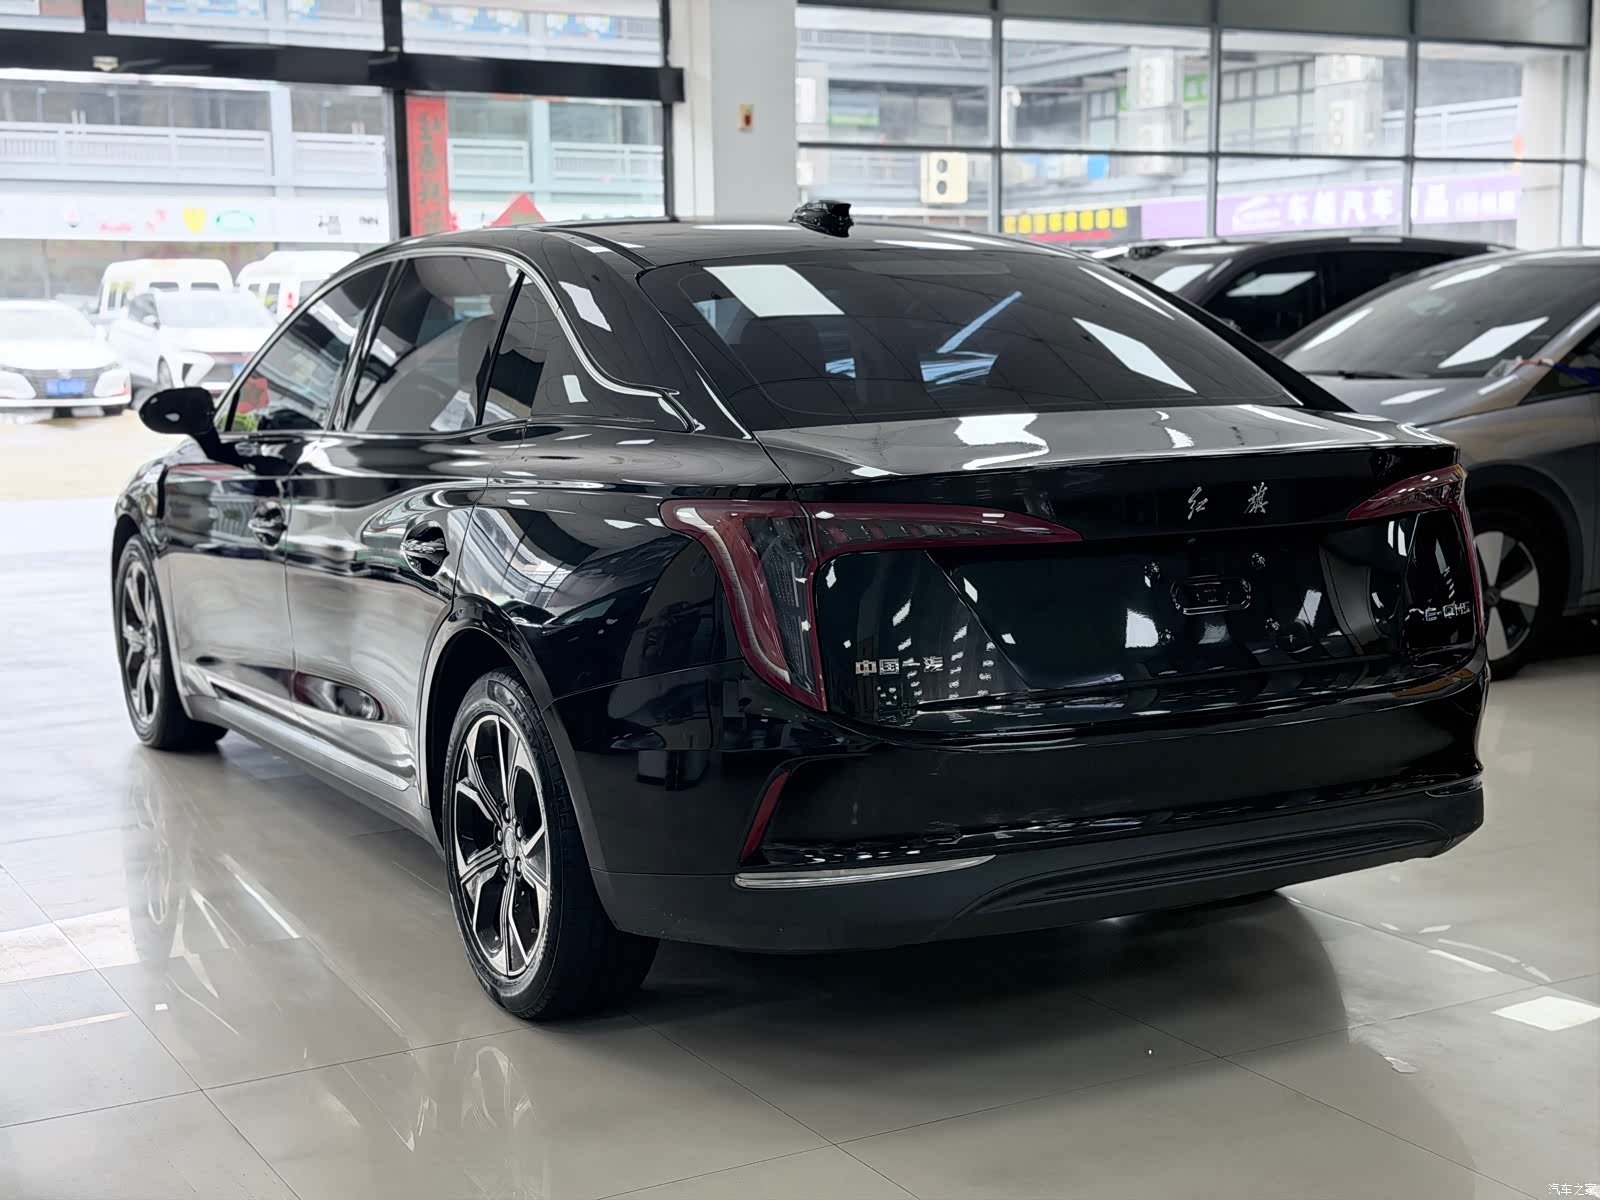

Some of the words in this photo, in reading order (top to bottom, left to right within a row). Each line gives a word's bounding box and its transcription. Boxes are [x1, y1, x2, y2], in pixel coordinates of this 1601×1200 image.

[1187, 481, 1269, 520] 红旗
[855, 656, 944, 676] 中国一汽
